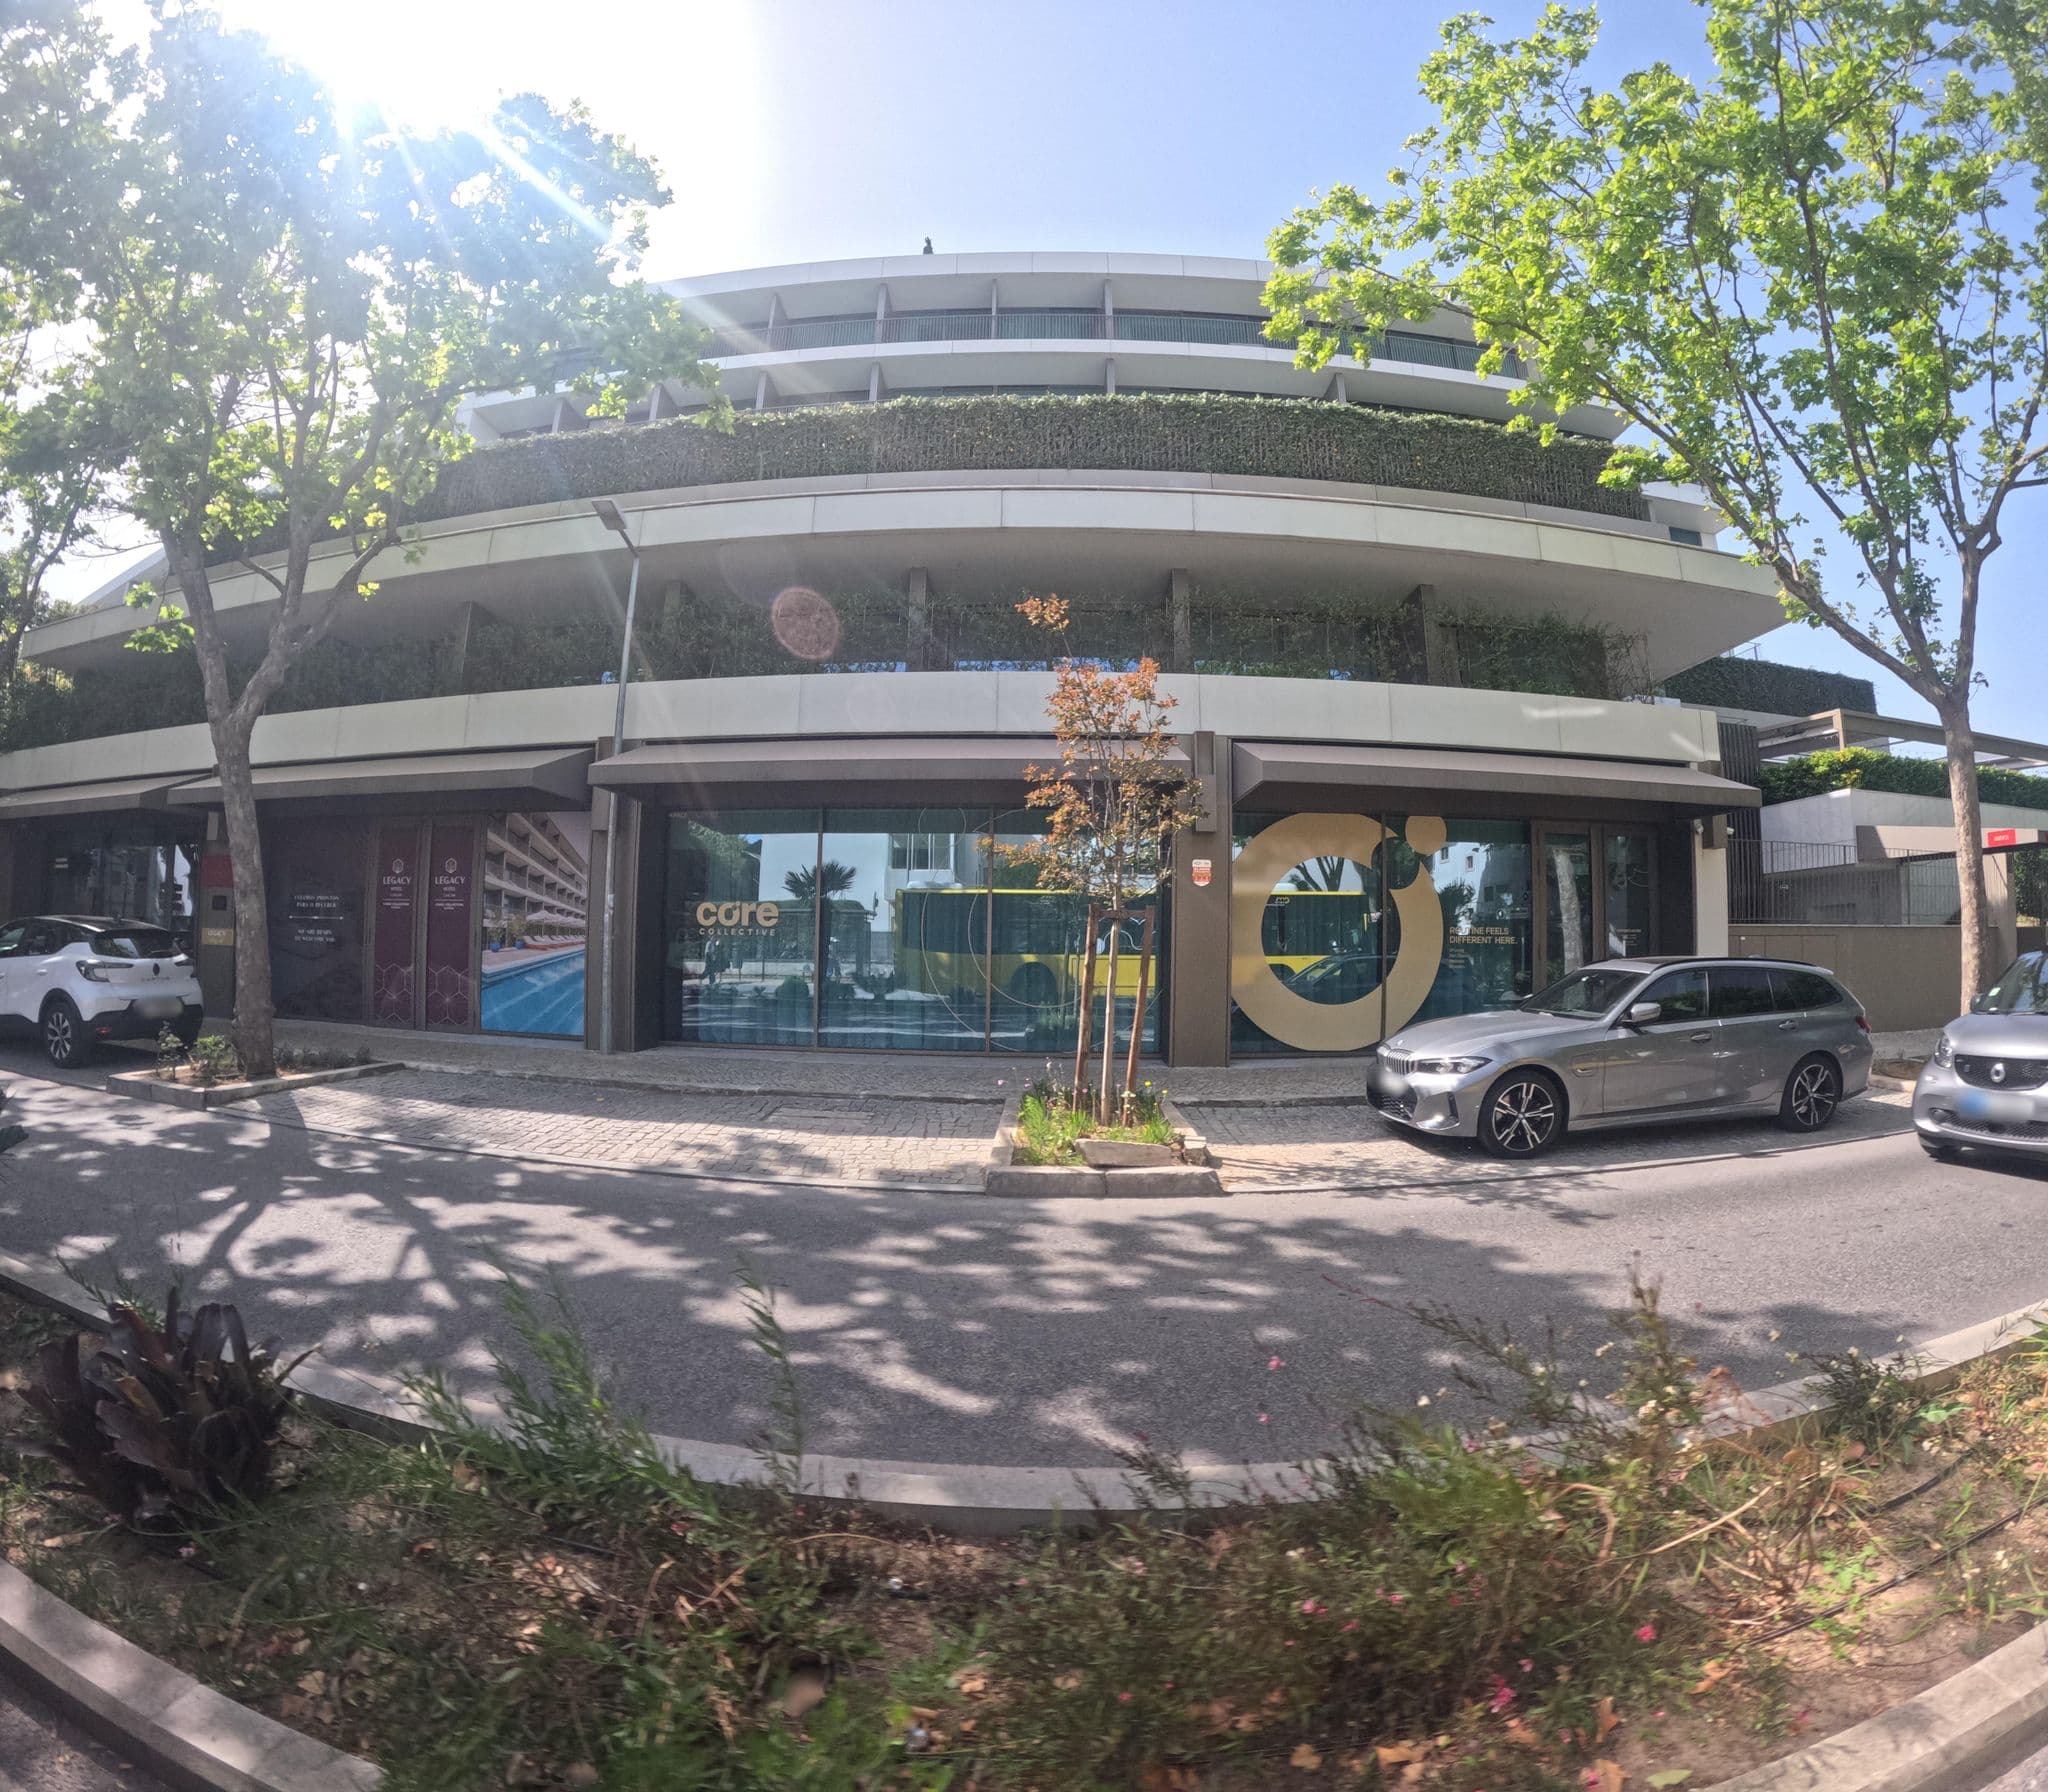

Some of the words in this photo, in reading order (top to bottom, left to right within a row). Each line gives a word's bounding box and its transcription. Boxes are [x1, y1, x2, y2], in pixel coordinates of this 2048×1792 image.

[383, 876, 411, 885] LEGACY
[435, 876, 465, 885] LEGACY
[696, 901, 779, 927] core
[699, 928, 776, 936] COLLECTIVE
[1485, 927, 1510, 935] FEELS
[1449, 935, 1493, 944] DIFFERENT
